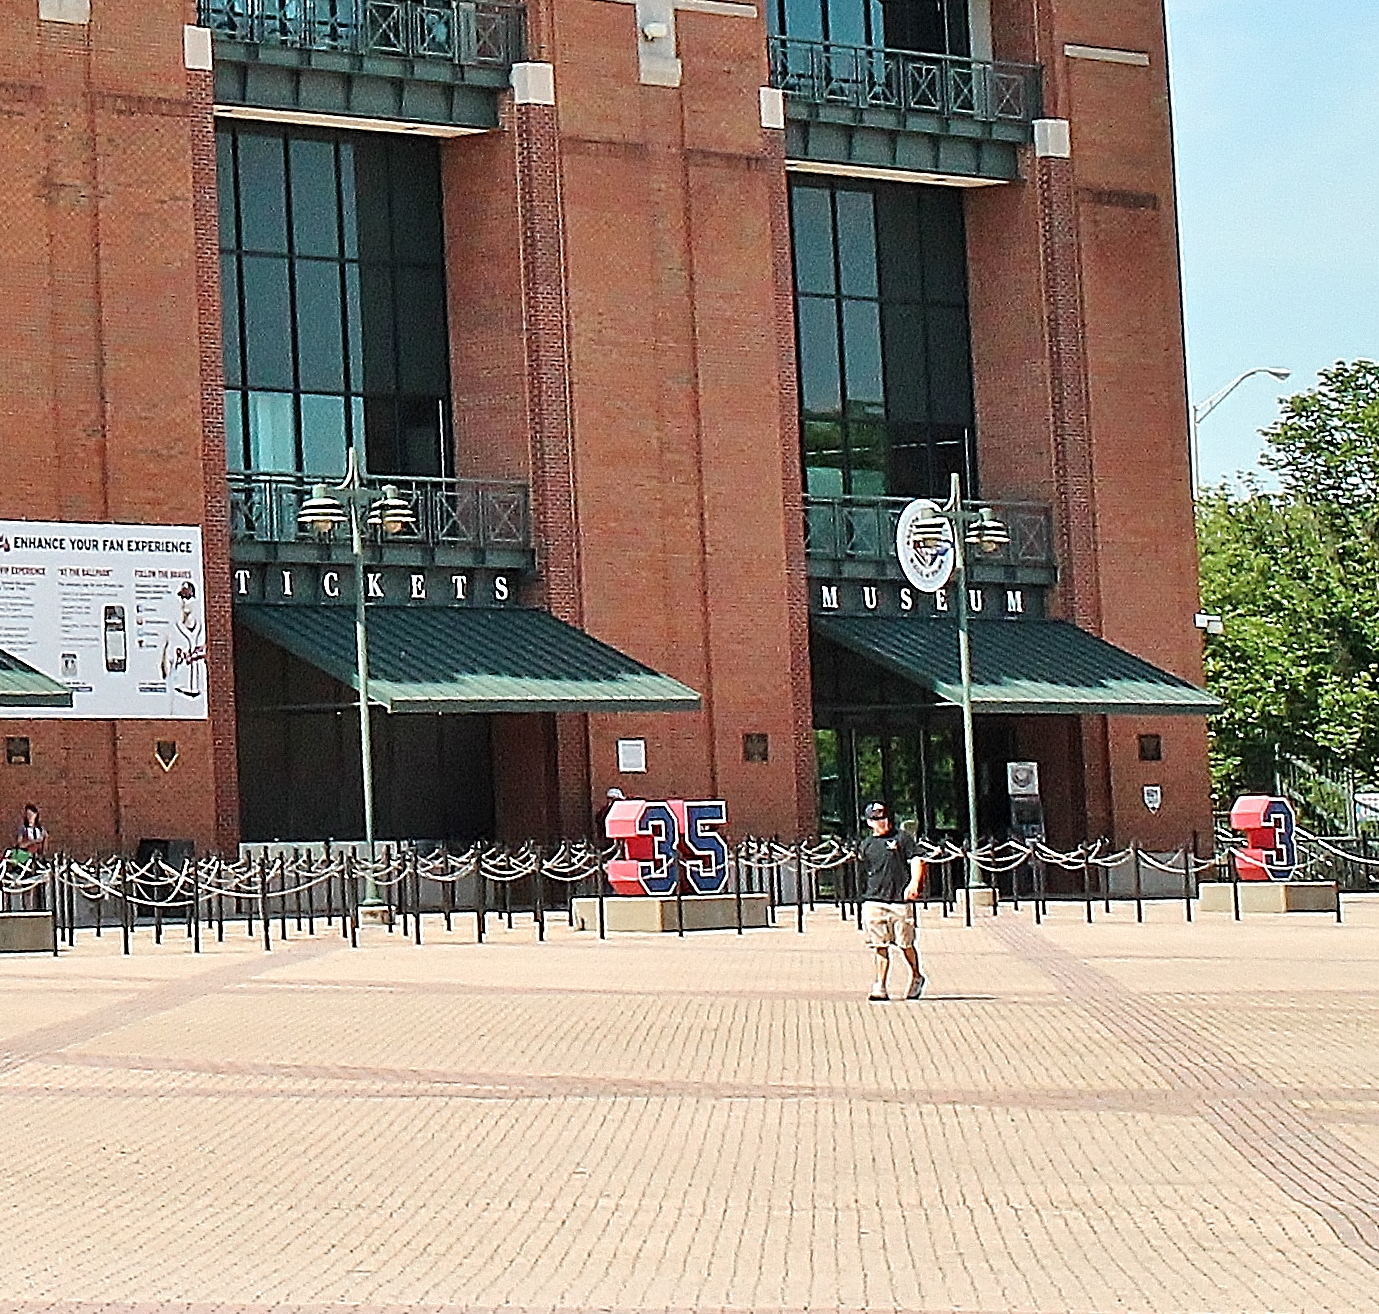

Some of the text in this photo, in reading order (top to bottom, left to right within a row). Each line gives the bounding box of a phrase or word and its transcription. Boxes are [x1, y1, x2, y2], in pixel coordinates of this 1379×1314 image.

[14, 536, 66, 550] ENHANCE
[70, 538, 98, 551] YOUR
[102, 539, 125, 552] FAN
[127, 540, 193, 554] EXPERIENCE
[234, 570, 509, 600] TICKETS
[821, 585, 1023, 613] MUSEUM
[609, 798, 729, 895] 35
[1241, 795, 1297, 881] 3
